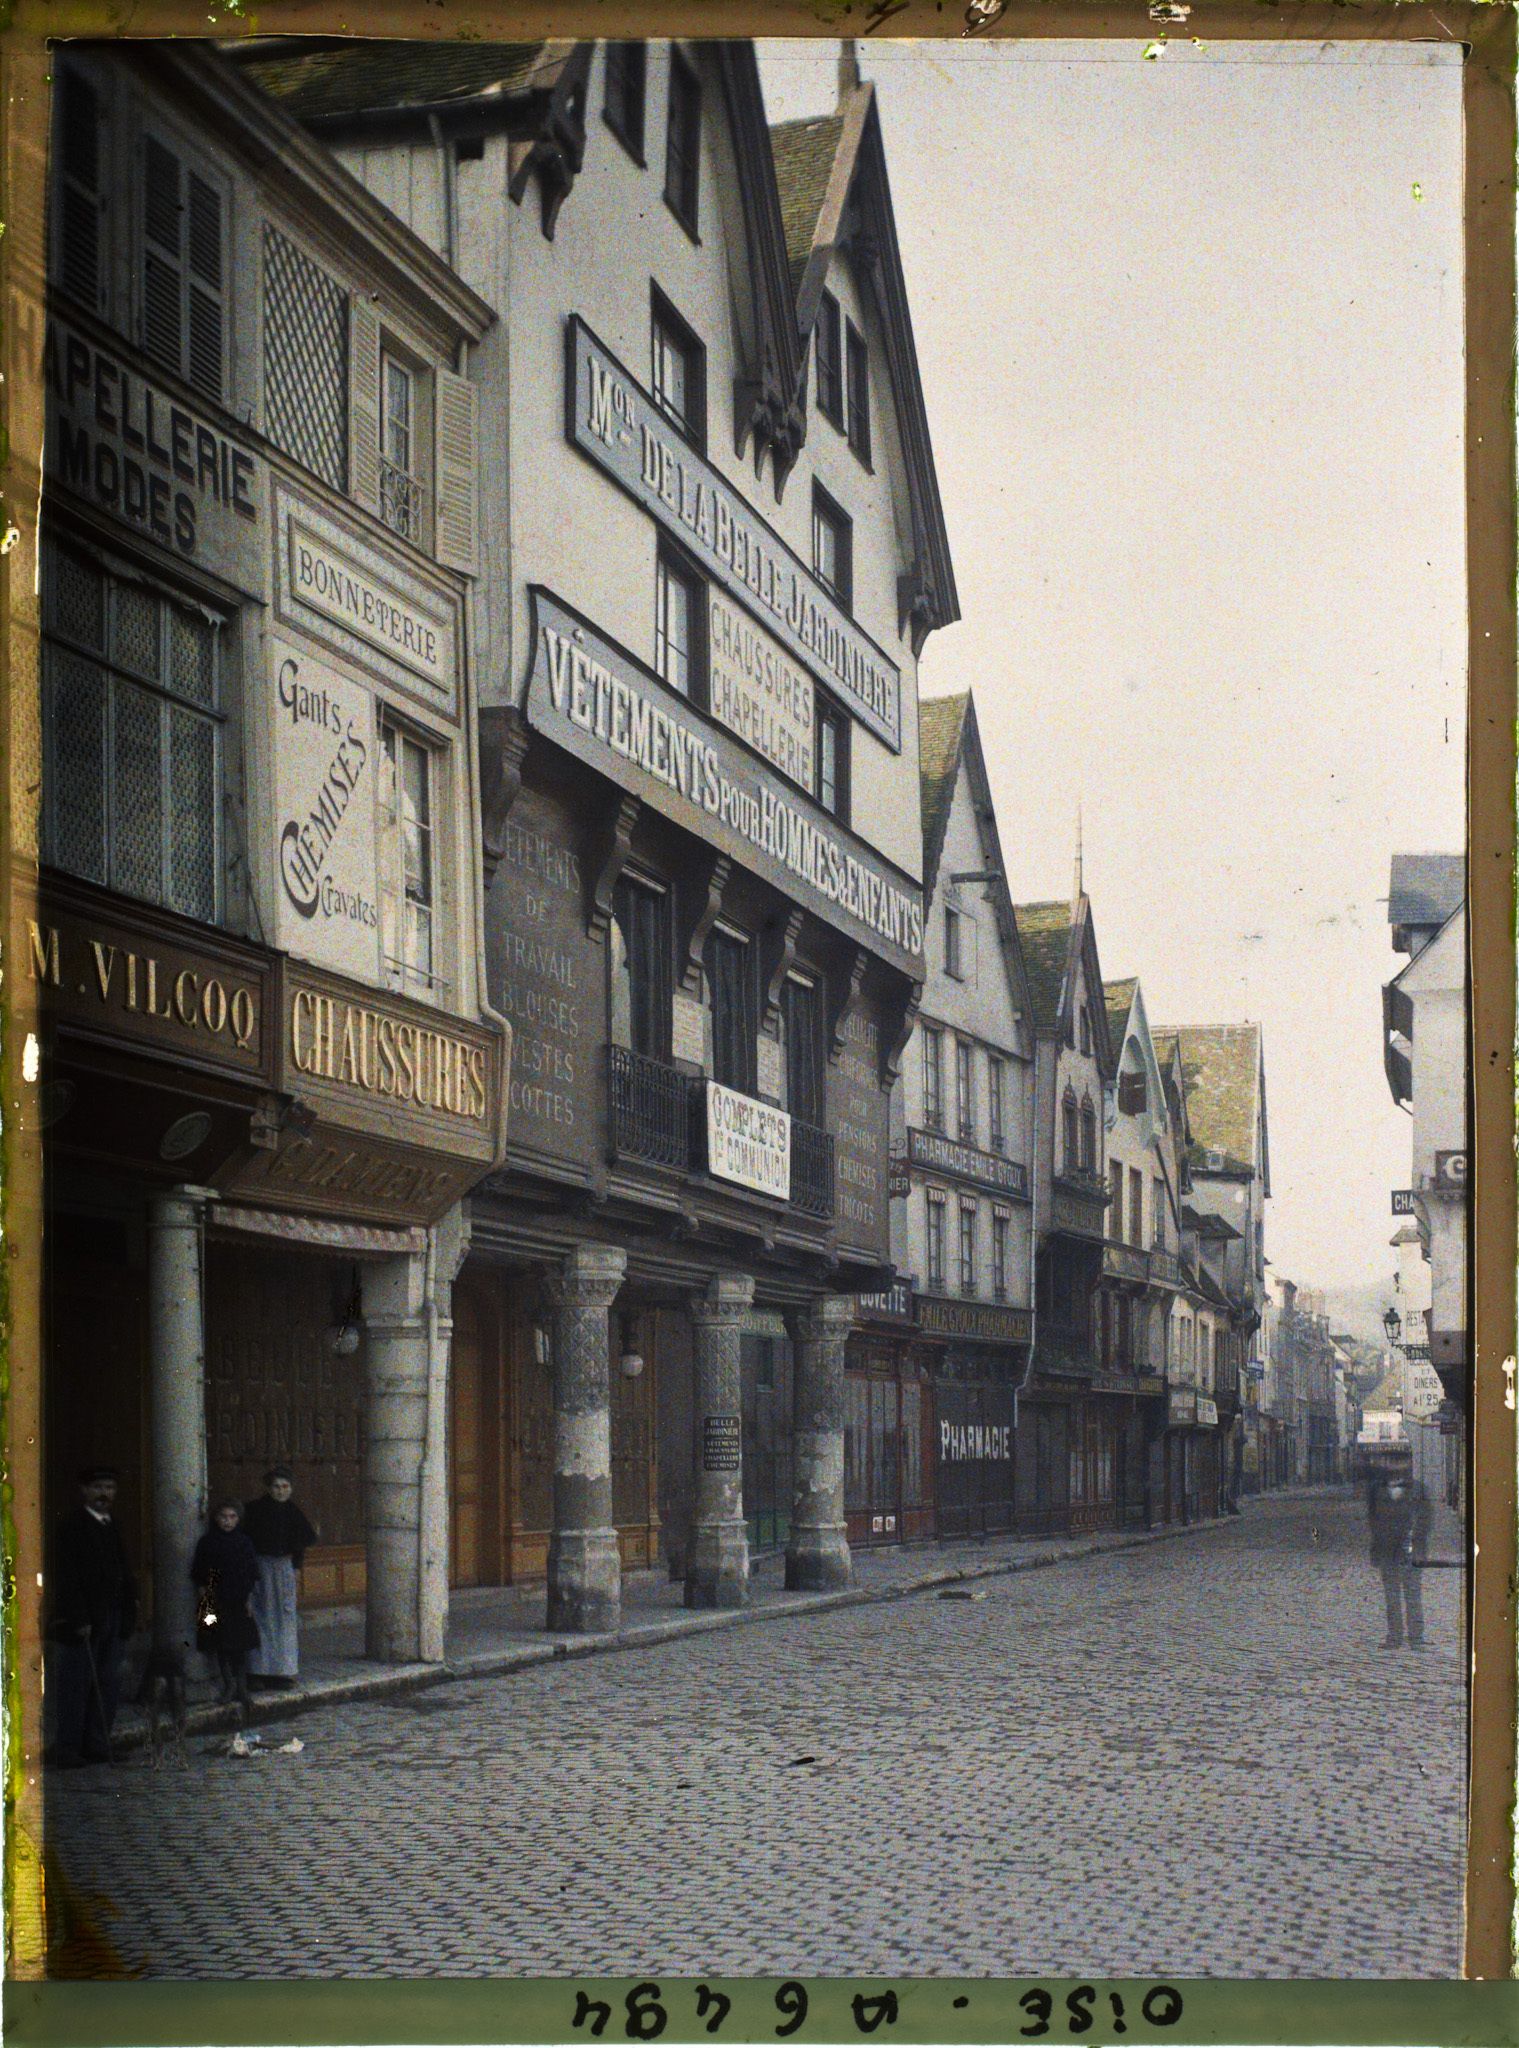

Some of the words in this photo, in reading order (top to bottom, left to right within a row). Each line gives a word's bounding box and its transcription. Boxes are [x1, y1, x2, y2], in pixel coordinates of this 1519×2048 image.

[58, 415, 196, 553] MODES
[713, 489, 784, 618] BELLE
[300, 547, 437, 664] BONNETERIE
[279, 658, 343, 736] Gants
[711, 602, 810, 728] CHAUSSURES
[711, 668, 811, 789] CHAPELLERIE
[718, 778, 760, 847] POUR
[759, 785, 840, 900] HOMMES
[846, 854, 921, 957] ENFANTS
[321, 875, 377, 928] Cravates
[503, 931, 576, 989] TRAVAIL
[90, 940, 254, 1049] VILCOQ
[502, 979, 579, 1038] BLOUSES
[292, 990, 485, 1119] CHAUSSURES
[510, 1080, 575, 1125] COTTES
[712, 1086, 786, 1153] COMPLETS
[726, 1137, 788, 1189] COMMUNION
[838, 1155, 876, 1190] CHEMISES
[914, 1132, 968, 1172] PHARMACIE
[970, 1152, 995, 1181] EMILE
[839, 1195, 874, 1225] TRICOTS
[940, 1420, 1010, 1460] PHARMACIE
